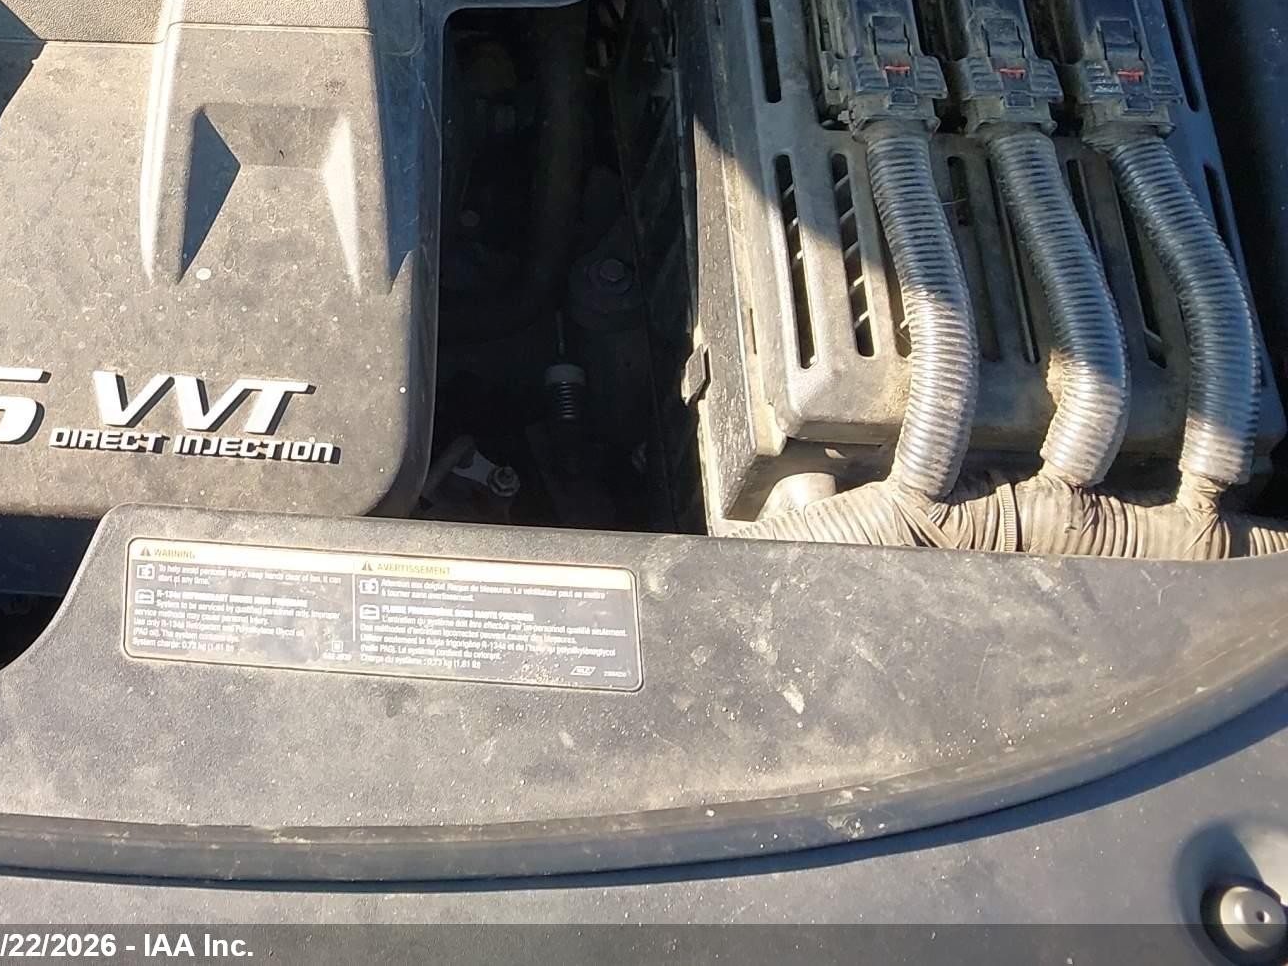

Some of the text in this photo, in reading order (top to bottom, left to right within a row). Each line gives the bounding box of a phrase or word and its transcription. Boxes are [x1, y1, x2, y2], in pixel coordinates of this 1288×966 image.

[92, 370, 311, 434] VVT
[49, 427, 169, 451] DIRECT
[377, 563, 451, 576] AVERTISSEMENT
